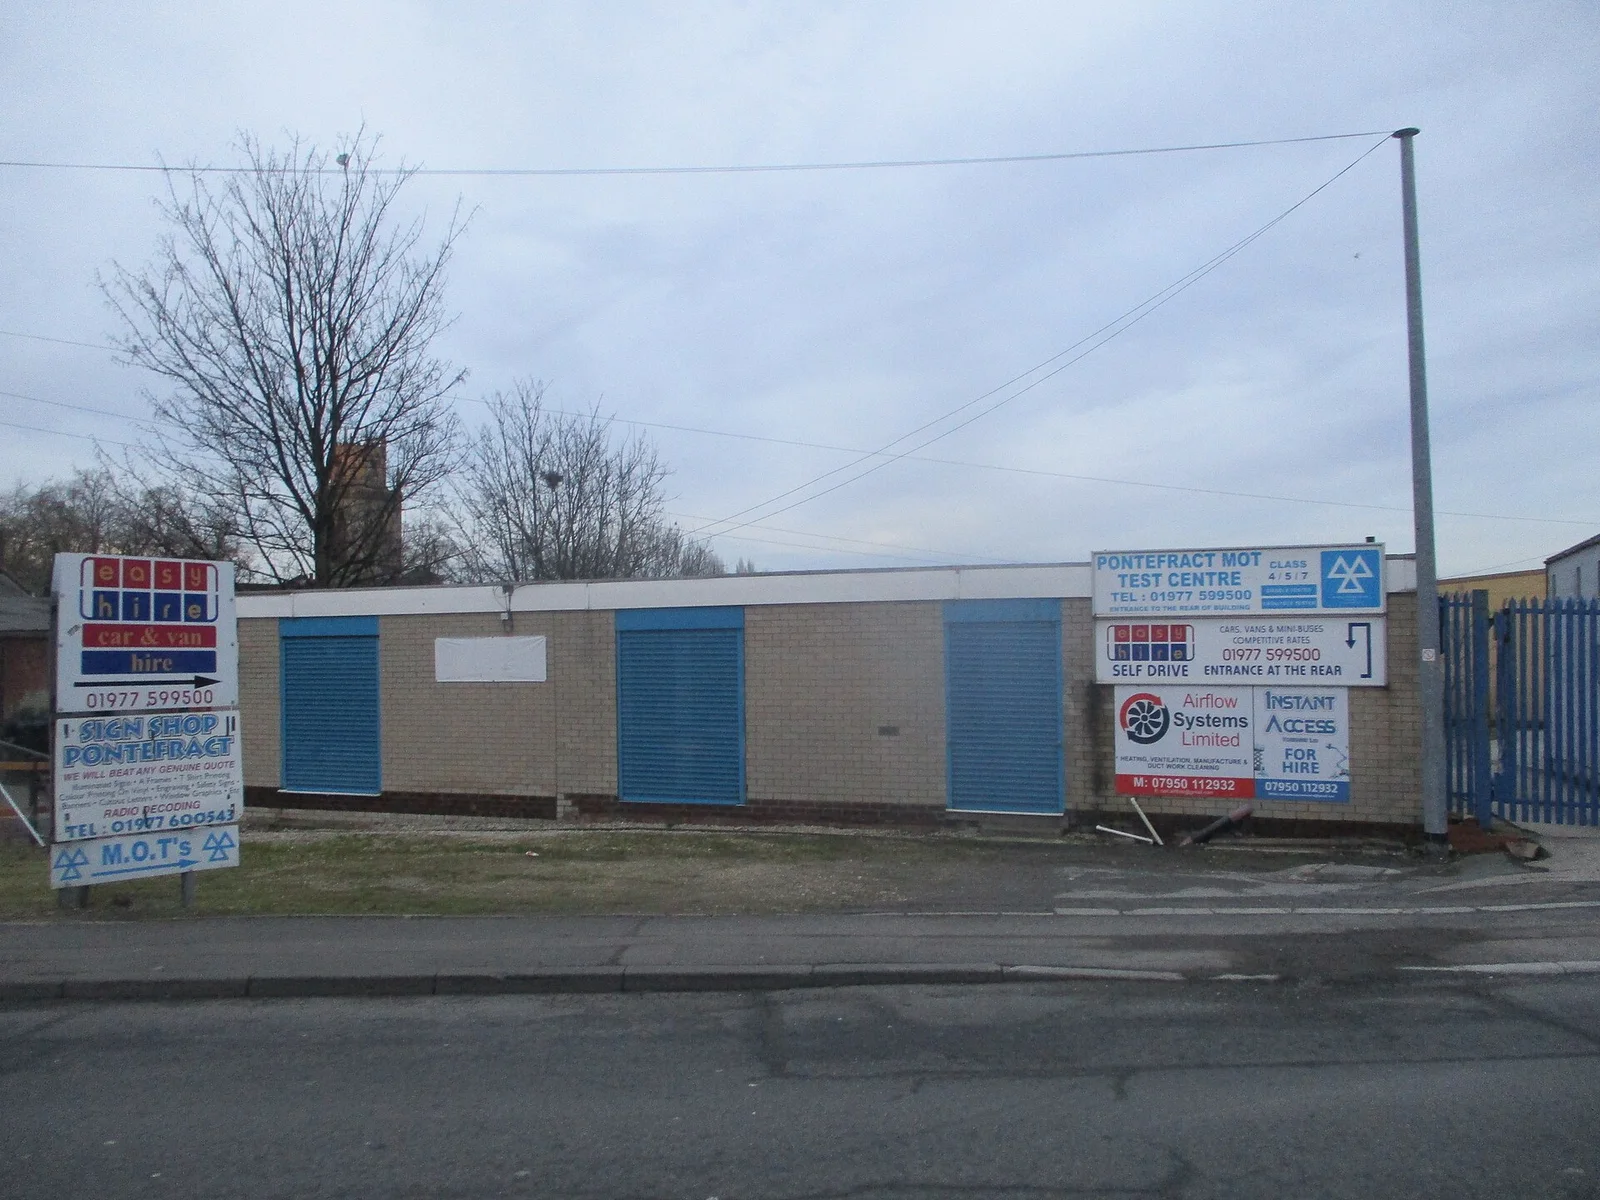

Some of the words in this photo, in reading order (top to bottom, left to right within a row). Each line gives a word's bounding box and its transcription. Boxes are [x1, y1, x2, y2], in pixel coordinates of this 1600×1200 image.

[1097, 552, 1216, 570] PONTEFRACT
[1222, 551, 1262, 567] MOT
[1269, 560, 1308, 569] CLASS
[99, 565, 202, 587] easy
[1118, 573, 1162, 588] TEST
[1168, 571, 1242, 587] CENTRE
[1111, 592, 1137, 602] TEL
[1150, 591, 1193, 602] 01977
[1199, 590, 1252, 601] 599500
[98, 594, 202, 619] hire
[1109, 605, 1149, 613] ENTRANCE
[1179, 604, 1200, 612] REAR
[97, 630, 134, 645] car
[140, 627, 160, 645] &
[166, 630, 202, 645] van
[1118, 628, 1183, 640] easy
[1245, 625, 1266, 633] VANS
[1268, 625, 1274, 633] &
[1276, 624, 1324, 633] MINI-BUSES
[1232, 636, 1281, 645] COMPETITIVE
[1286, 636, 1311, 644] RATES
[1118, 646, 1183, 659] hire
[1222, 648, 1261, 661] 01977
[1266, 648, 1321, 661] 599500
[131, 653, 173, 672] hire
[1112, 664, 1142, 677] SELF
[1147, 664, 1189, 677] DRIVE
[1204, 665, 1263, 676] ENTRANCE
[1267, 665, 1281, 676] AT
[1284, 665, 1306, 676] THE
[1310, 665, 1342, 676] REAR
[87, 692, 139, 708] 01977
[147, 689, 213, 706] 599500
[1183, 693, 1238, 708] Airflow
[1265, 691, 1335, 710] INSTANT
[79, 717, 144, 743] SIGN
[147, 713, 219, 738] SHOP
[1173, 711, 1249, 731] Systems
[1265, 714, 1336, 733] ACCESS
[1182, 731, 1240, 747] Limited
[63, 735, 234, 768] PONTEFRACT
[1285, 748, 1317, 760] FOR
[63, 772, 80, 781] WE
[83, 770, 106, 780] WILL
[109, 767, 135, 778] BEAT
[135, 766, 157, 776] ANY
[159, 762, 201, 774] GENUINE
[203, 760, 235, 770] QUOTE
[1282, 761, 1319, 774] HIRE
[1133, 777, 1148, 788] M:
[1152, 777, 1188, 789] 07950
[1192, 779, 1236, 791] 112932
[1265, 781, 1299, 792] 07950
[1302, 782, 1338, 793] 112932
[104, 806, 139, 818] RADIO
[143, 800, 200, 815] DECODING
[65, 823, 97, 839] TEL
[111, 816, 164, 833] 01977
[169, 809, 235, 827] 600543
[102, 836, 192, 865] M.O.T's
